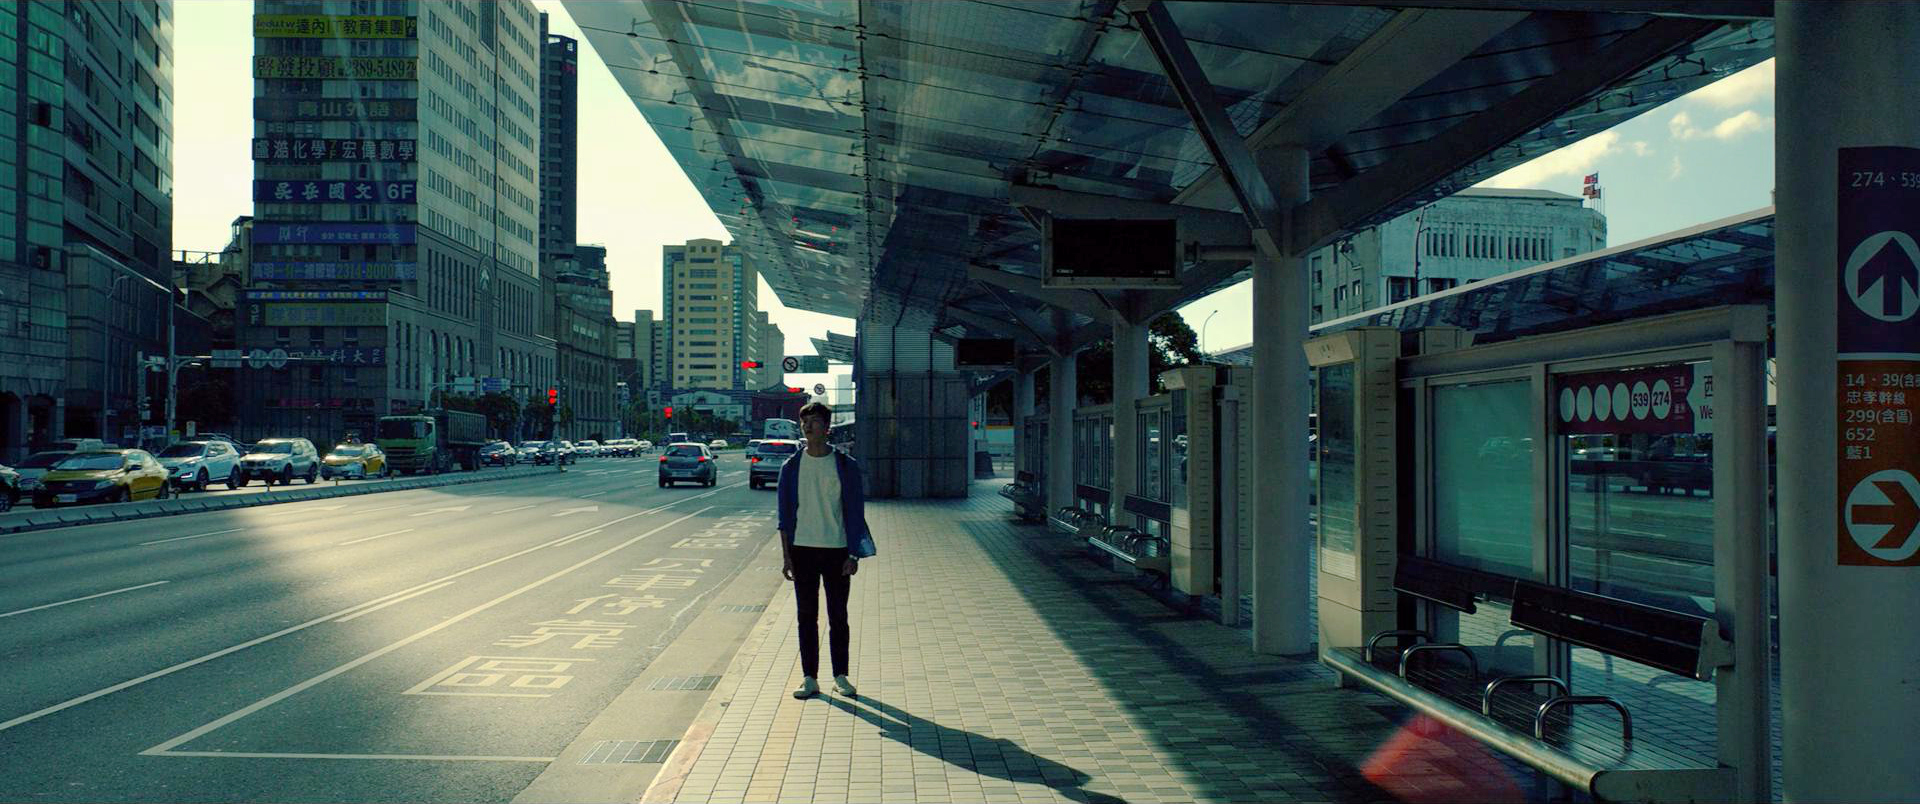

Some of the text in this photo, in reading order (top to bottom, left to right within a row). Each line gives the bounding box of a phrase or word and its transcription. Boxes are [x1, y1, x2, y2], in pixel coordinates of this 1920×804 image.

[387, 183, 414, 199] 6F
[1633, 391, 1648, 407] 539
[1653, 390, 1670, 406] 274
[1846, 428, 1876, 442] 652
[1846, 446, 1872, 460] 藍1
